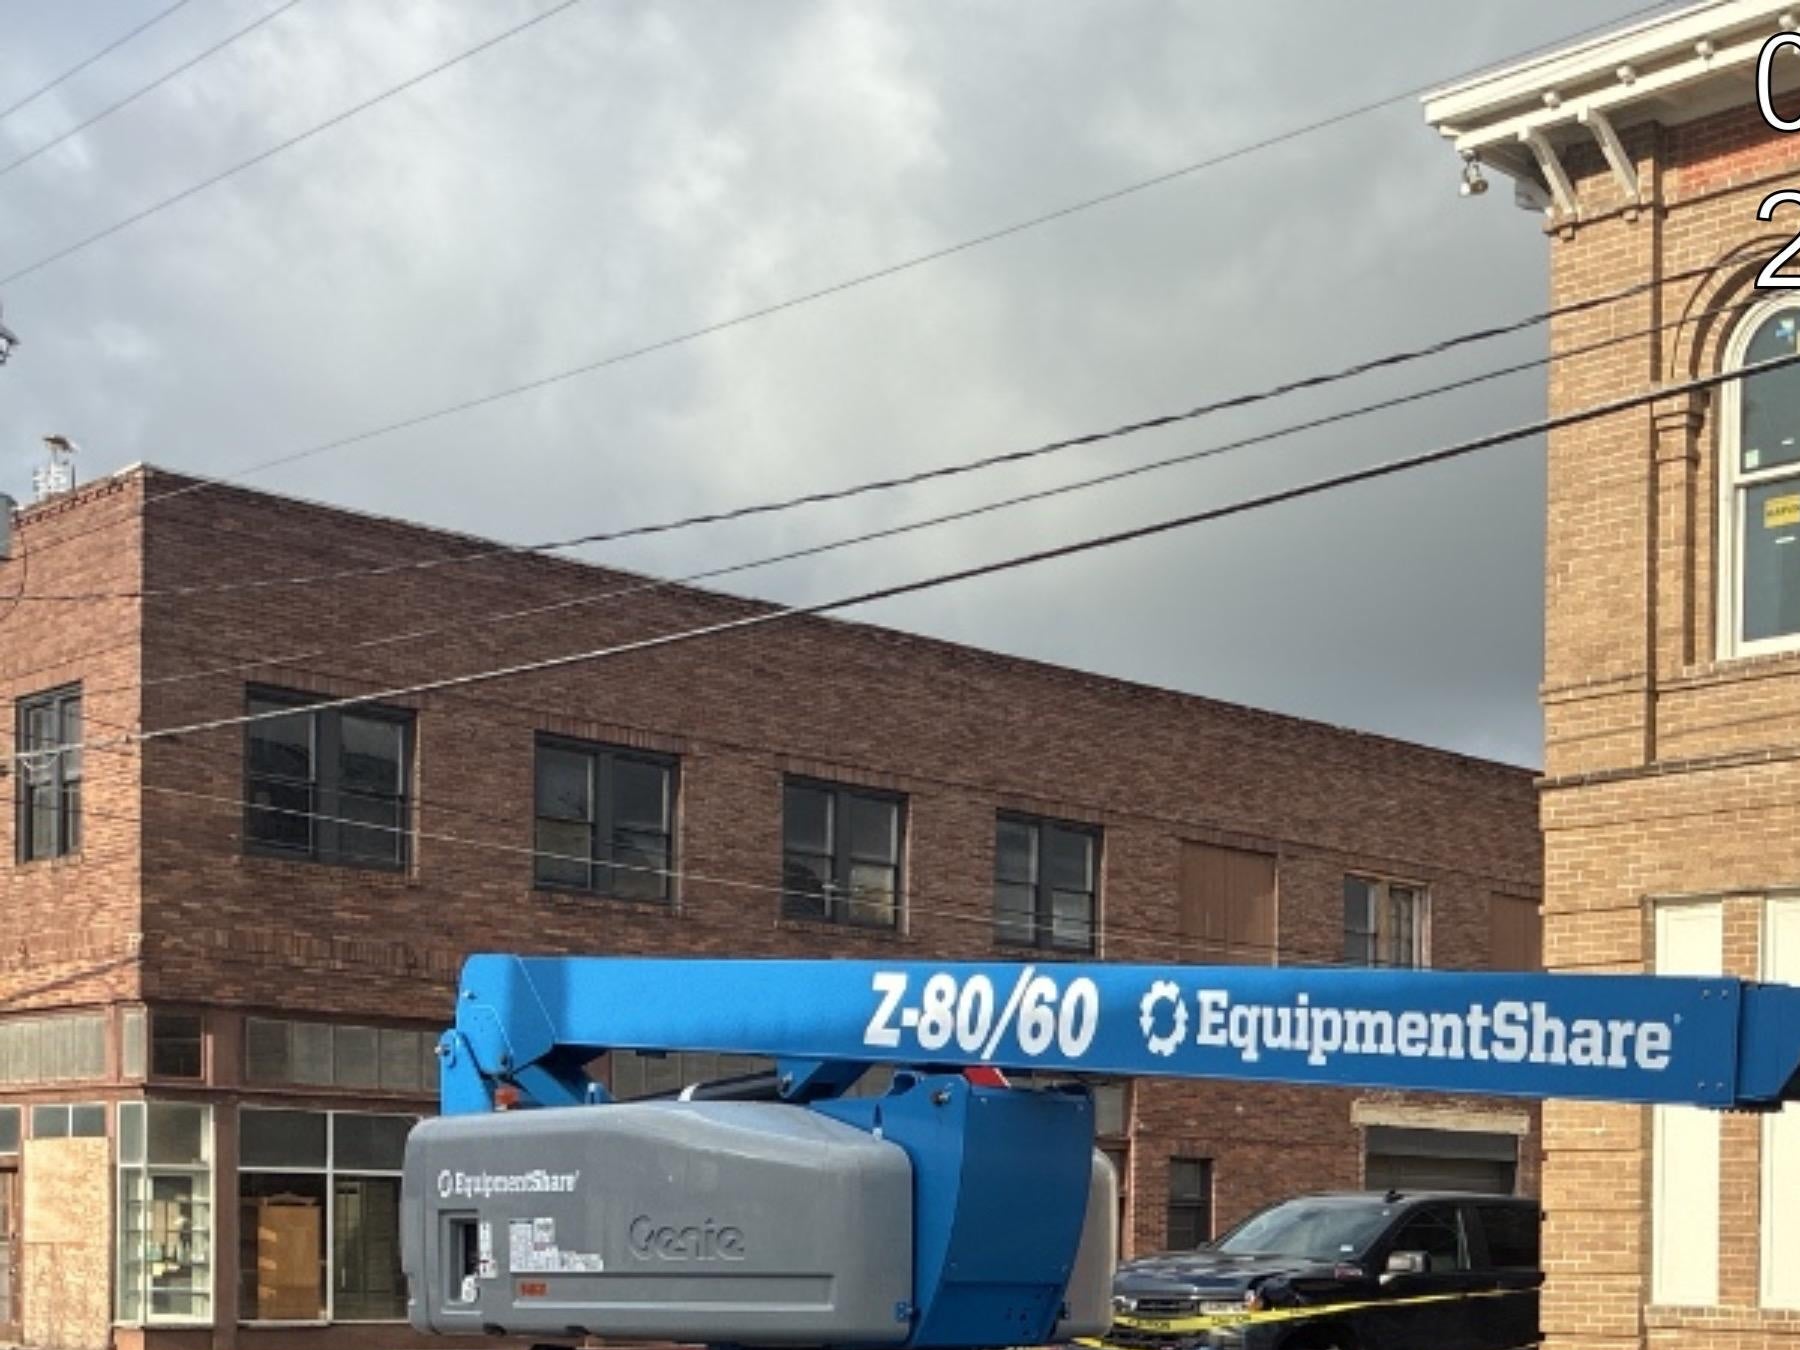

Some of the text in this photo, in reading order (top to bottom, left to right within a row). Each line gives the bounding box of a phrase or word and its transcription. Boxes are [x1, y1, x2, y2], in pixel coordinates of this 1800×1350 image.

[862, 966, 1672, 1072] Z-80/60 EquipmentShare
[455, 1169, 576, 1198] EquipmentShare
[629, 1214, 745, 1261] Genie
